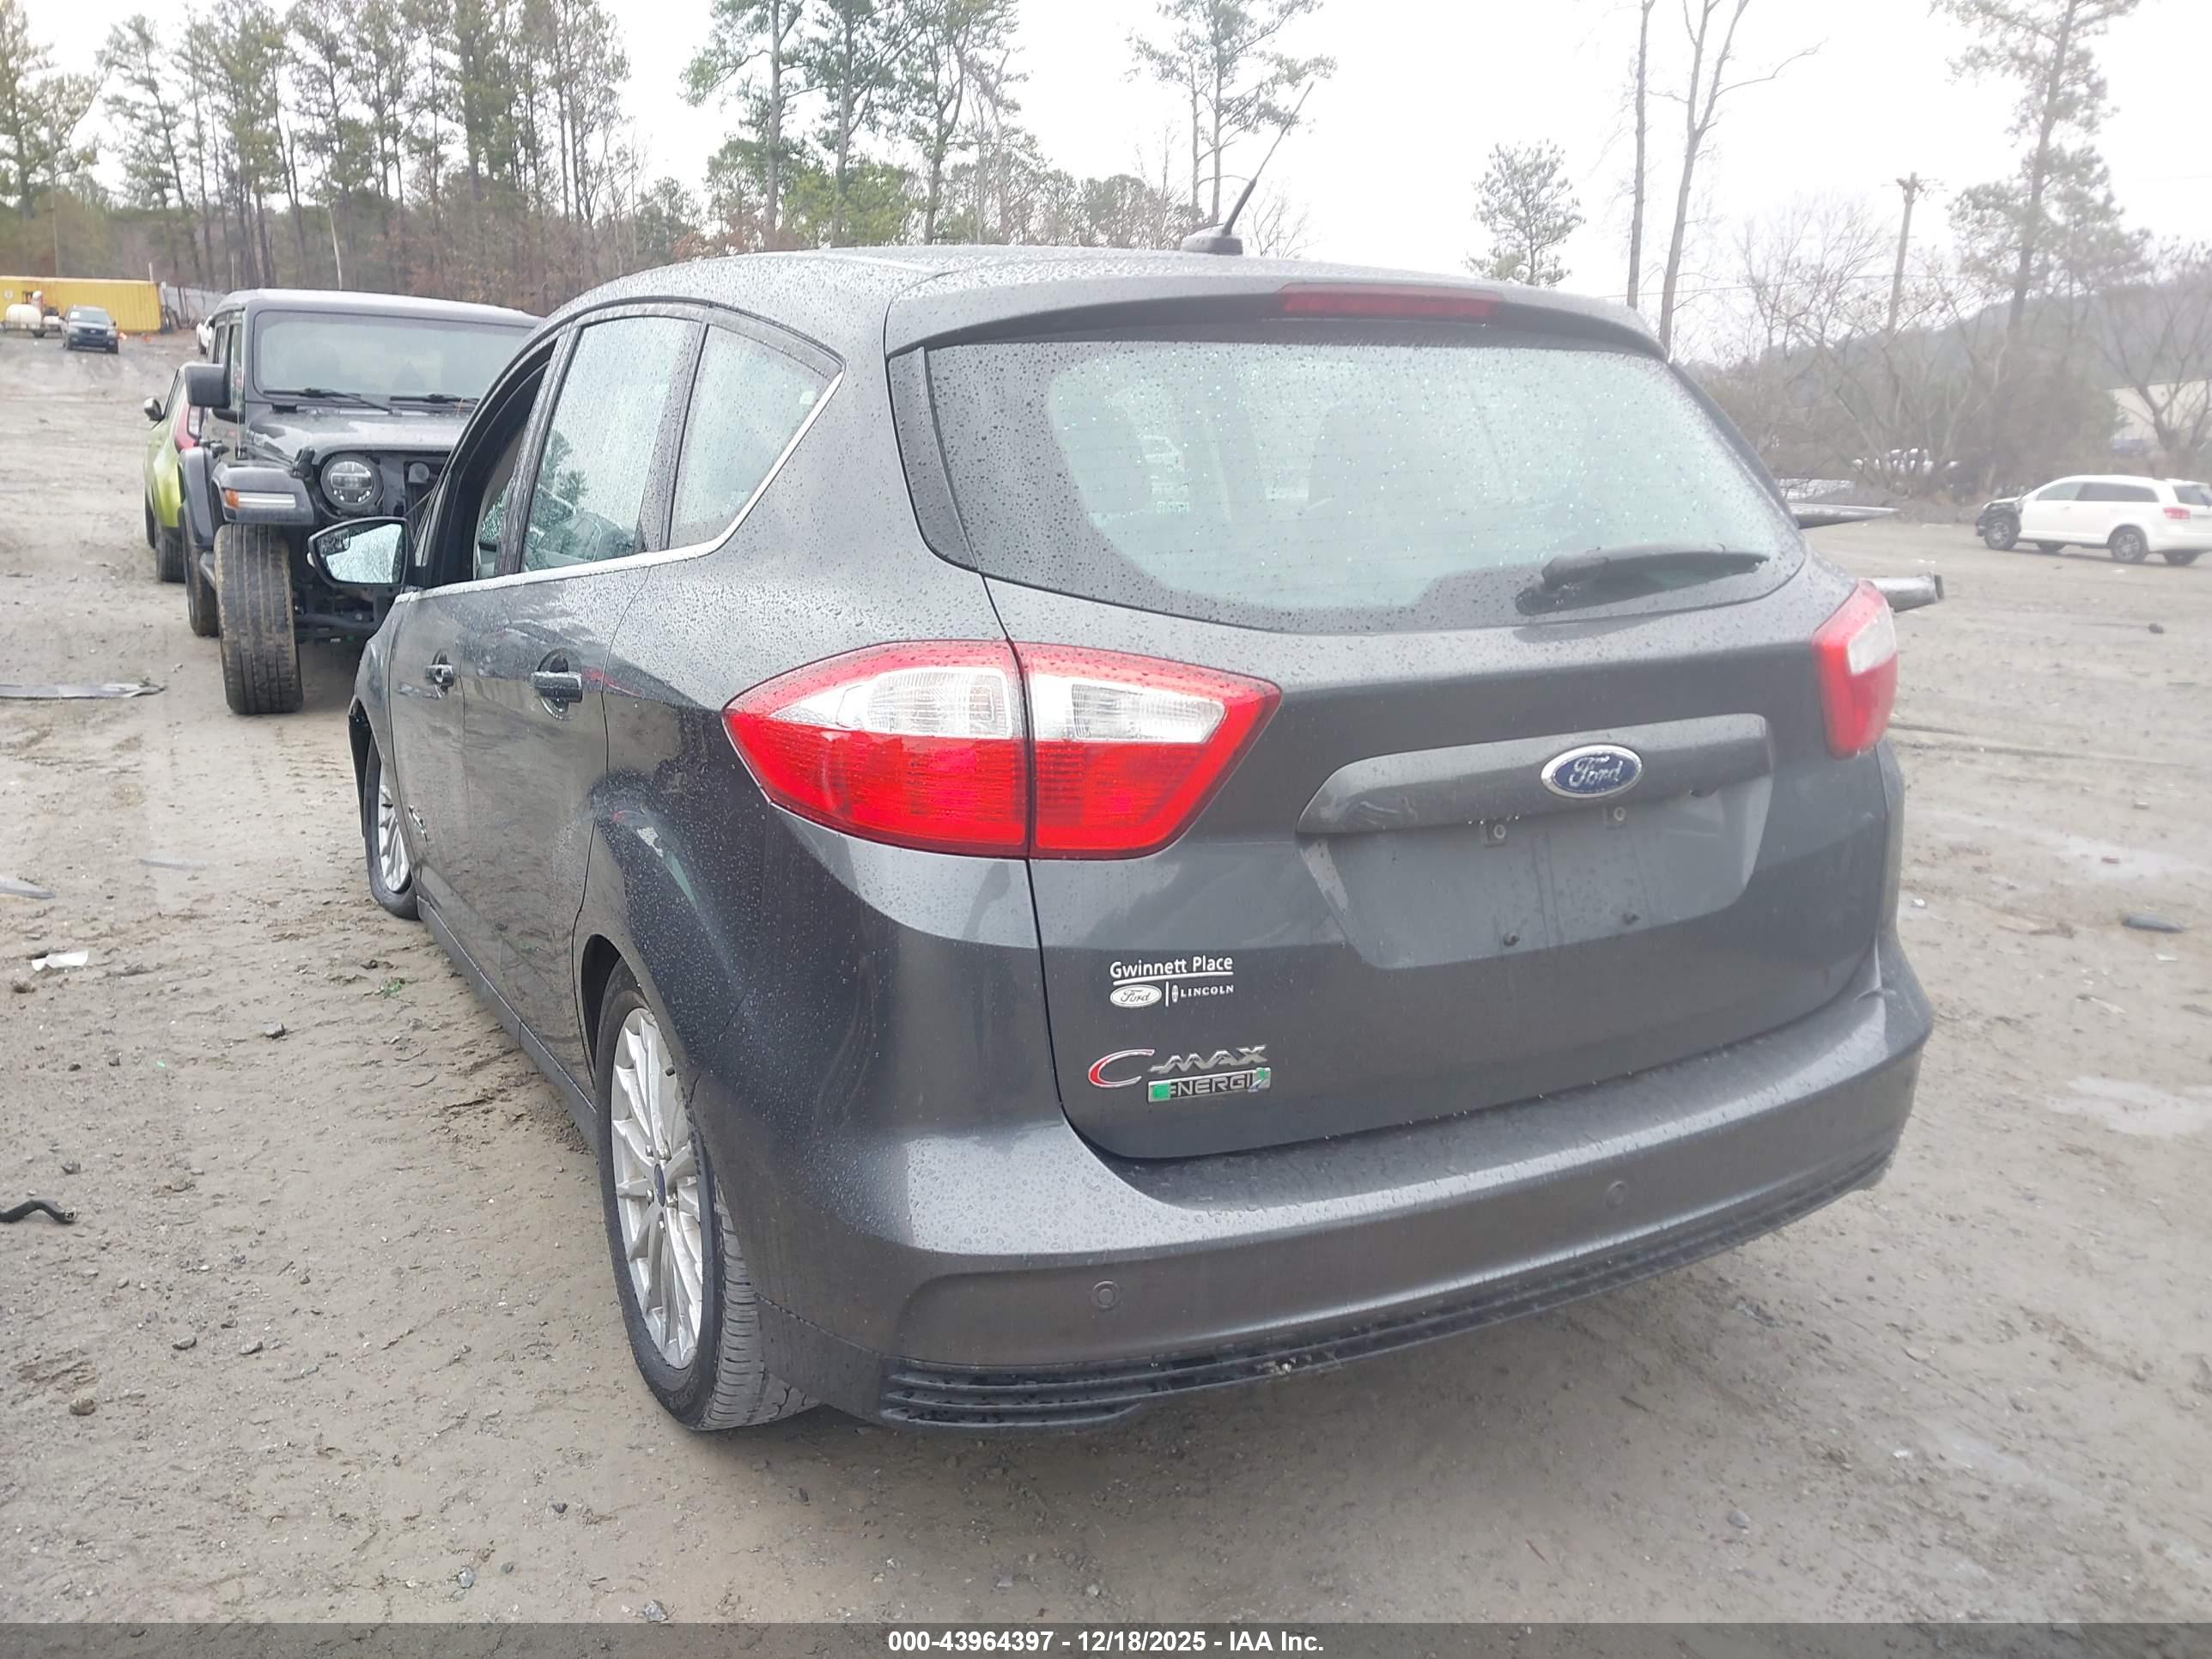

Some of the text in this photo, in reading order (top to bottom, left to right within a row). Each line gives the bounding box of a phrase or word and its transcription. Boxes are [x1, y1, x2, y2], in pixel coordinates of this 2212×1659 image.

[1569, 756, 1623, 787] Ford
[1109, 954, 1233, 978] Gwinnett Place
[1120, 984, 1234, 1003] Ford LINCOLN
